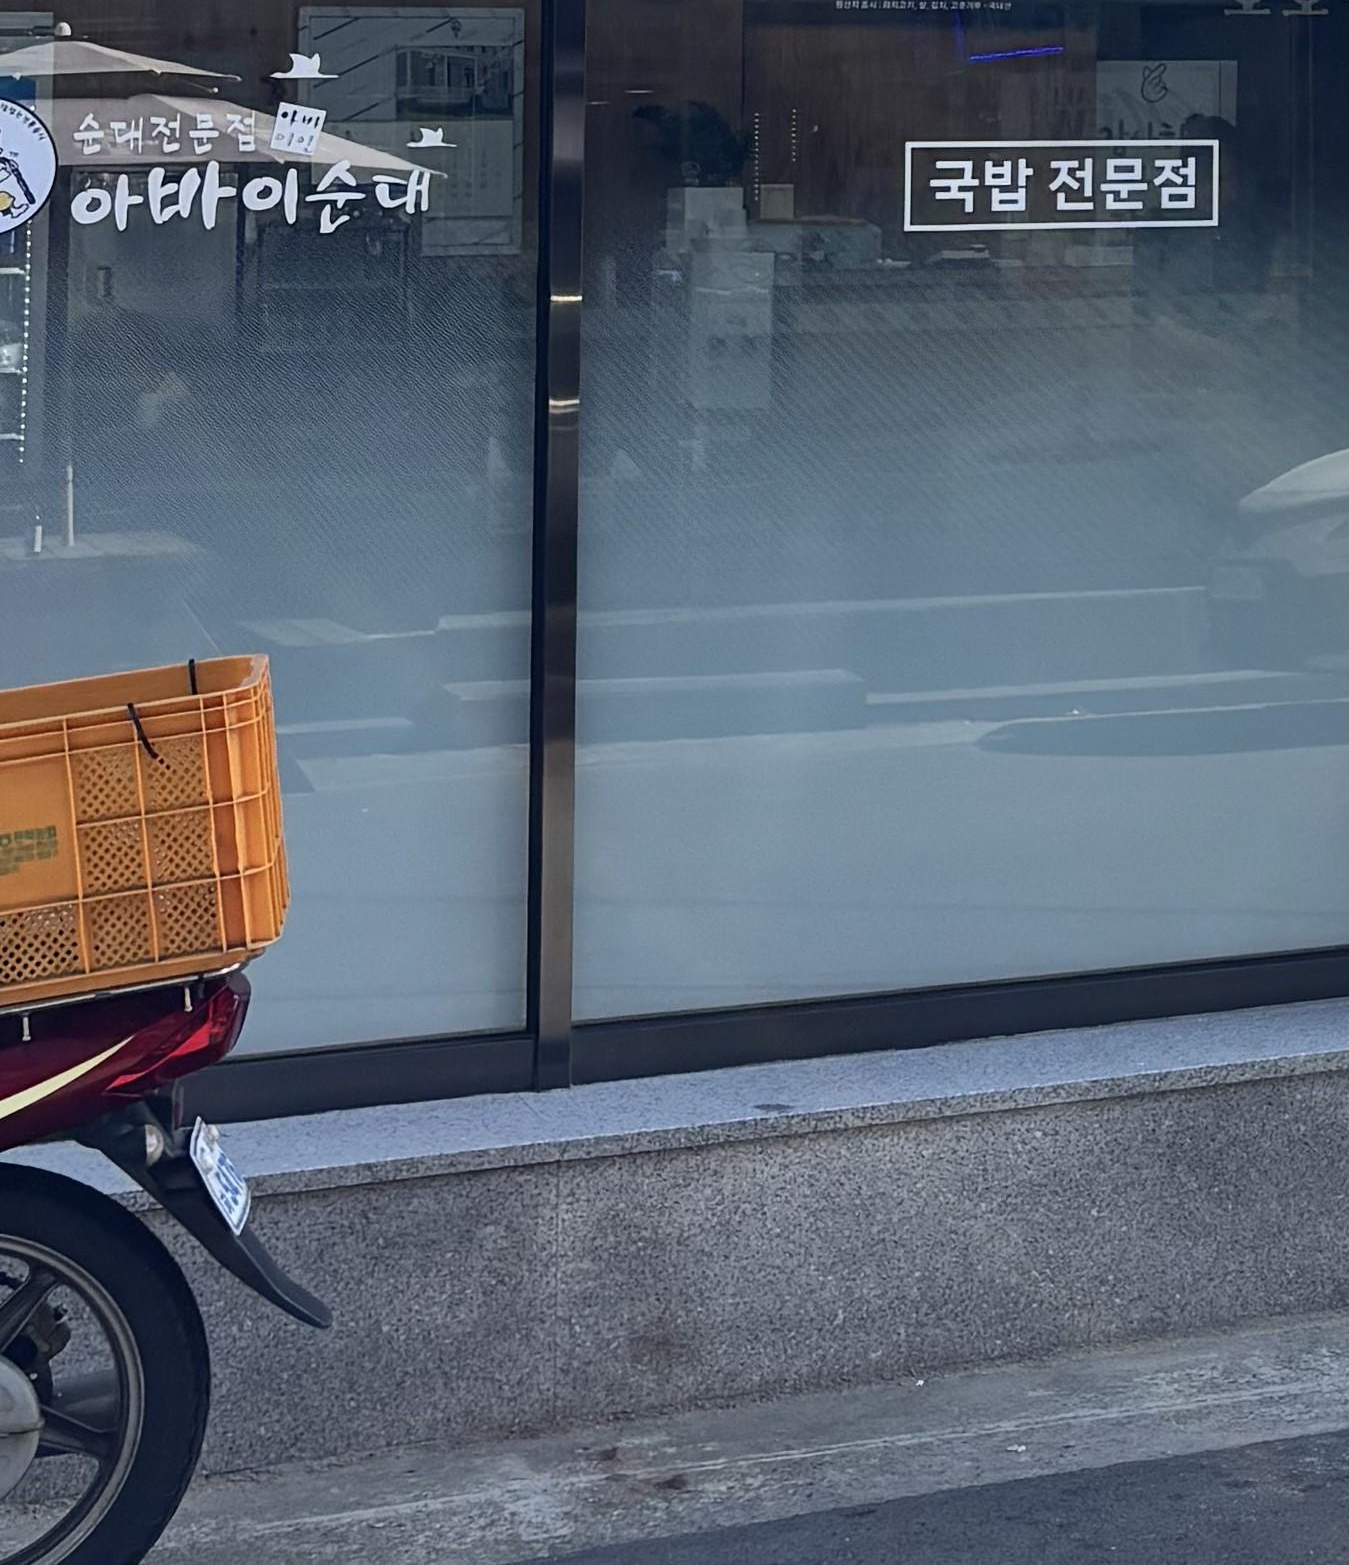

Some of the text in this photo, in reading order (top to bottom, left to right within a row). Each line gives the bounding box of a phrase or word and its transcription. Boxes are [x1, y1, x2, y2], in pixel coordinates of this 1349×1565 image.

[73, 109, 257, 153] 순대전문점
[70, 159, 432, 234] 아바이순대
[929, 156, 1196, 213] 국밥 전문점
